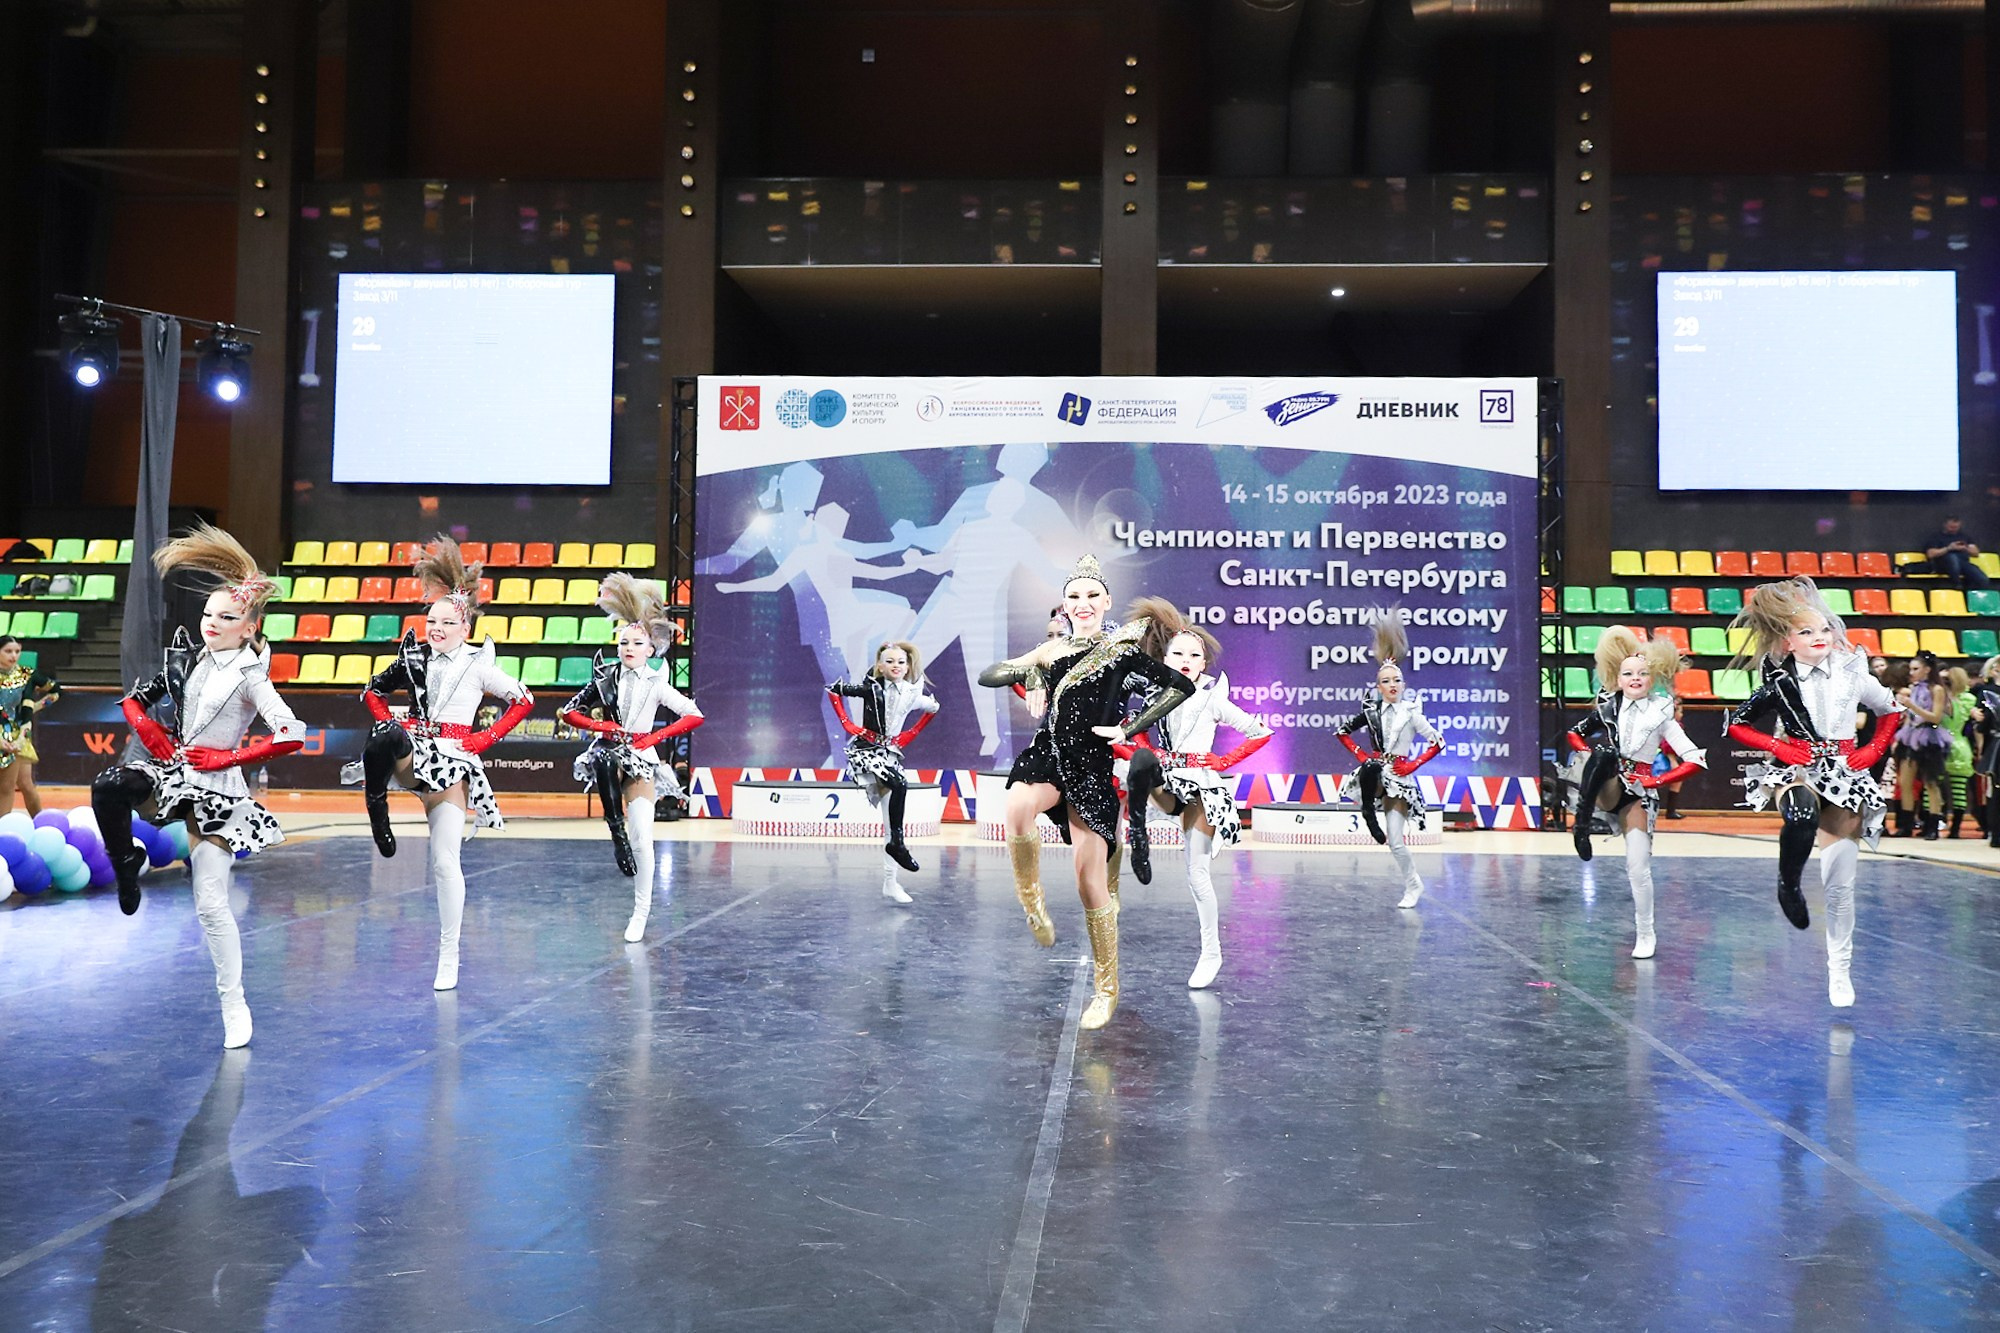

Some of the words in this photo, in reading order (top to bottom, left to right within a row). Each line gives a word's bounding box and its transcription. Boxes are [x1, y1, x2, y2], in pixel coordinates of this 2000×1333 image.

[352, 316, 376, 336] 29
[1673, 316, 1699, 337] 29
[1097, 407, 1176, 419] ФЕДЕРАЦИЯ
[1356, 402, 1459, 419] ДНЕВНИК
[1485, 397, 1508, 415] 78
[1222, 484, 1247, 504] 14
[1265, 484, 1288, 504] 15
[1294, 485, 1389, 506] октября
[1394, 485, 1449, 505] 2023
[1455, 489, 1507, 506] года
[1114, 522, 1286, 549] Чемпионат
[1293, 530, 1311, 549] и
[1321, 522, 1507, 555] Первенство
[1219, 559, 1507, 595] Санкт-Петербурга
[1189, 606, 1227, 625] по
[1311, 645, 1508, 671] рок--роллу
[1230, 681, 1377, 706] тербургский
[1403, 686, 1510, 703] естиваль
[494, 758, 554, 771] Петербурга
[825, 793, 840, 819] 2
[1348, 814, 1359, 833] 3
